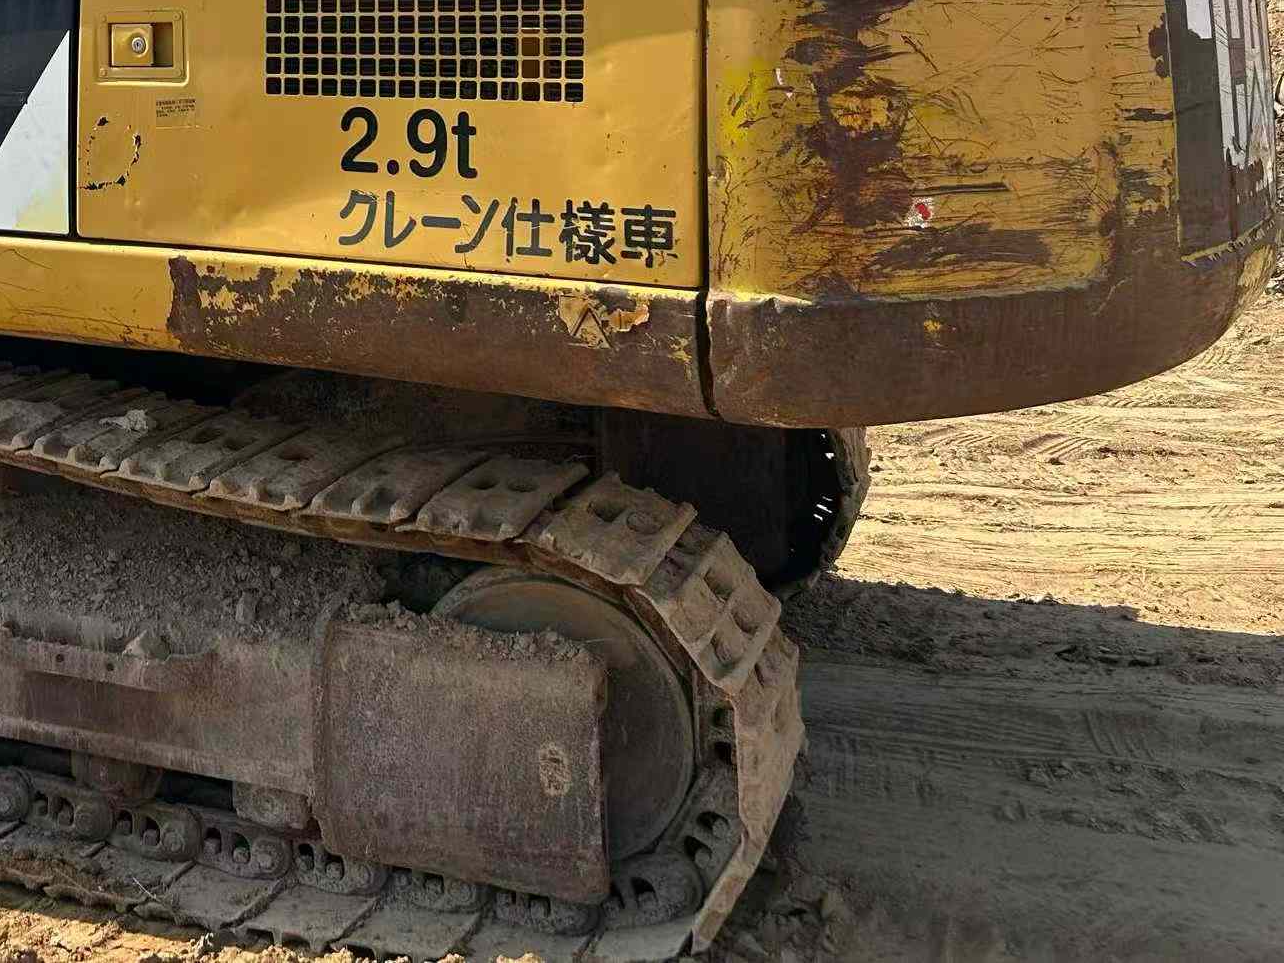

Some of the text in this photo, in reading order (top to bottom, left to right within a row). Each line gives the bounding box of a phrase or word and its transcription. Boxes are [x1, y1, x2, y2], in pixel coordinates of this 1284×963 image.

[339, 106, 478, 179] 2.9t
[338, 189, 677, 268] クレーン仕様車
